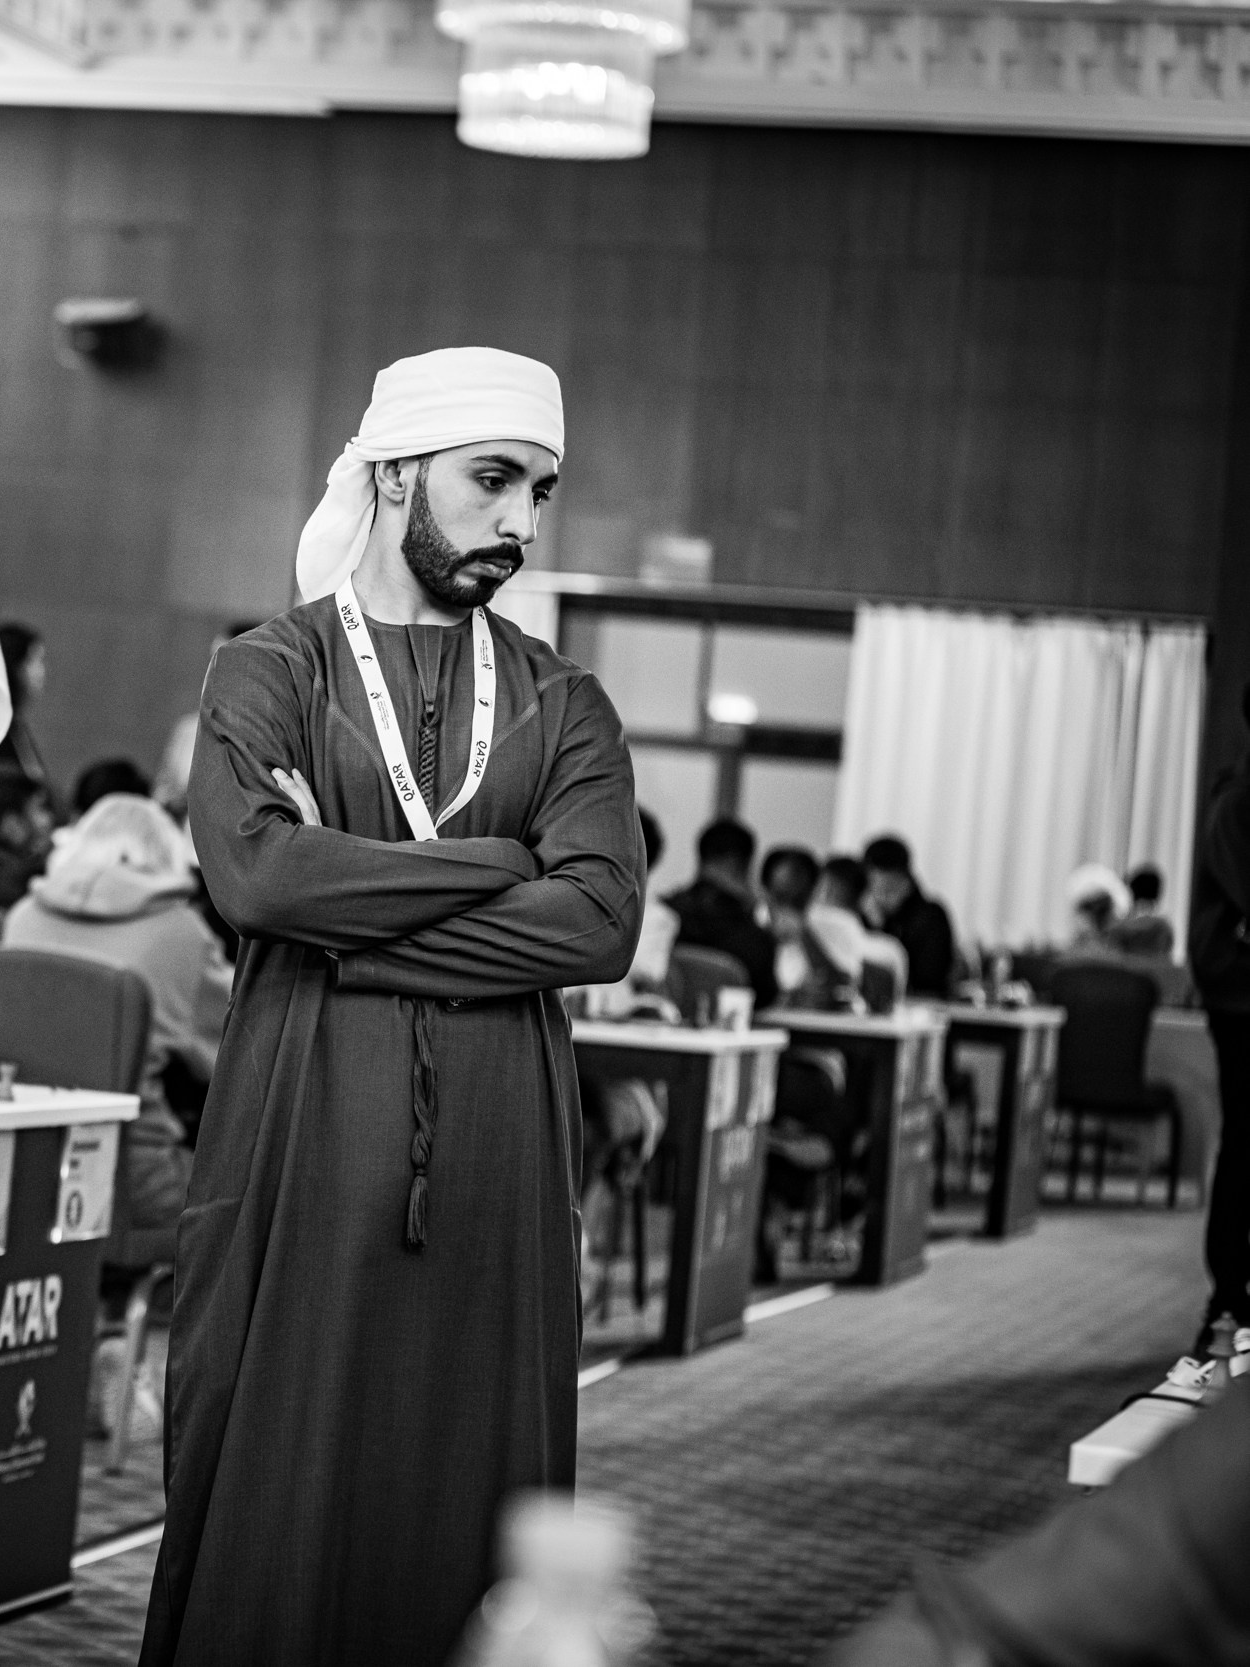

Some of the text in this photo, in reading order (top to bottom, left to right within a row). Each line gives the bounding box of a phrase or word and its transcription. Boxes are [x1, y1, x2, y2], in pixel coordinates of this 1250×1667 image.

[341, 603, 360, 631] QATAR
[473, 740, 488, 778] QATAR
[392, 763, 416, 802] QATAR
